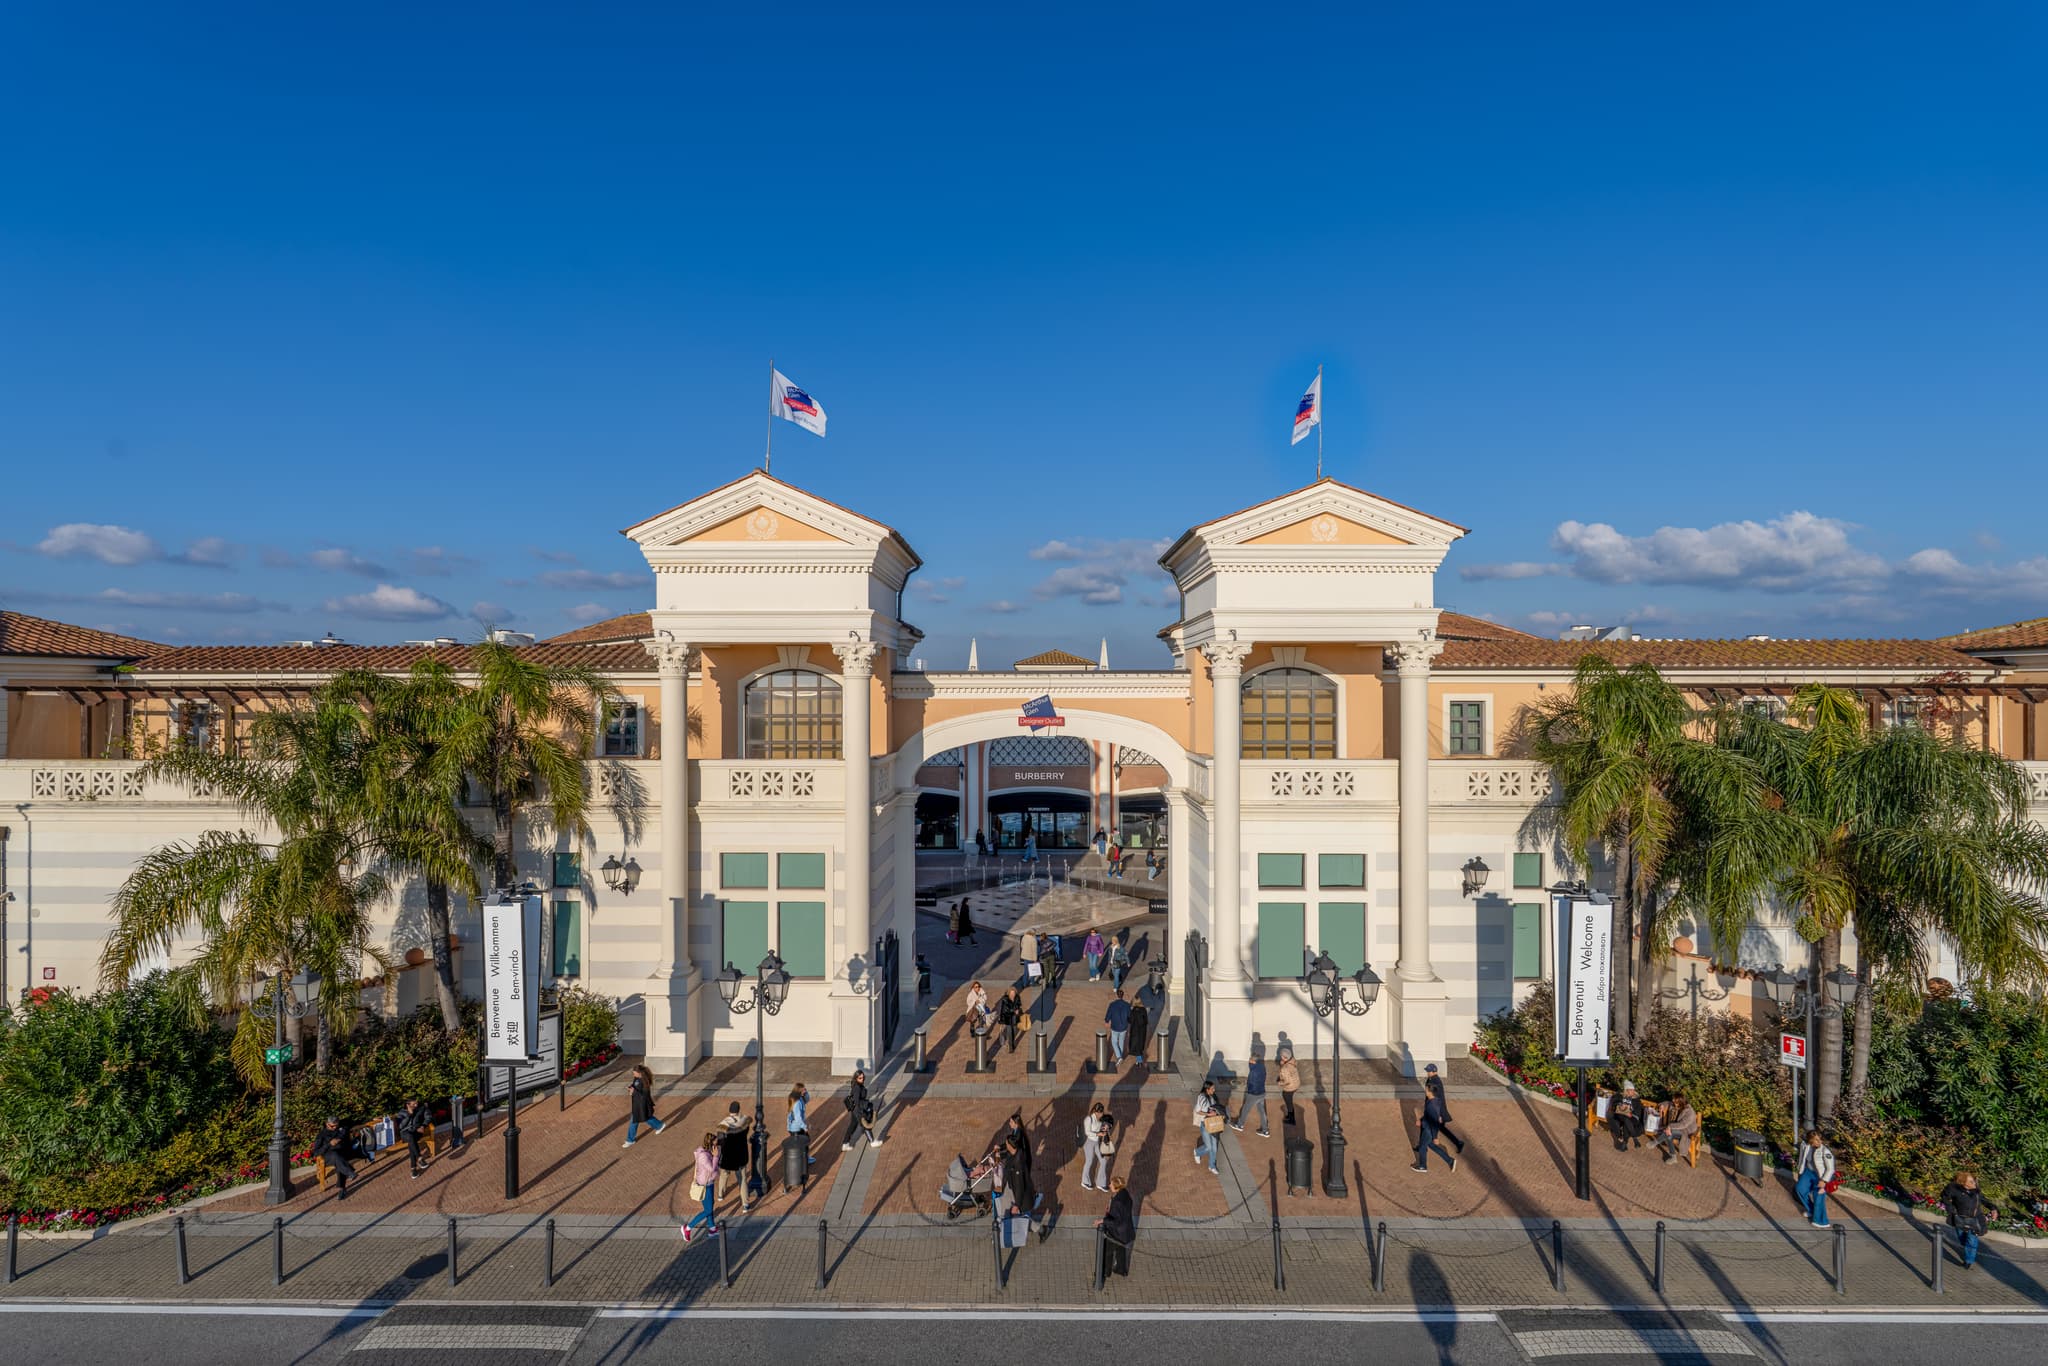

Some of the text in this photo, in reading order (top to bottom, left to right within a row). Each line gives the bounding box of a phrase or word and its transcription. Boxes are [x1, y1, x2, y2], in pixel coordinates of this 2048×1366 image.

[1025, 707, 1039, 716] Glen
[1015, 772, 1065, 780] BURBERRY
[489, 916, 501, 1038] Bienvenue Willkommen
[510, 949, 520, 1000] Bem-vindo
[1571, 915, 1594, 1036] Benvenuti Welcome
[1597, 977, 1606, 1002] Добро
[507, 1021, 519, 1046] 欢迎
